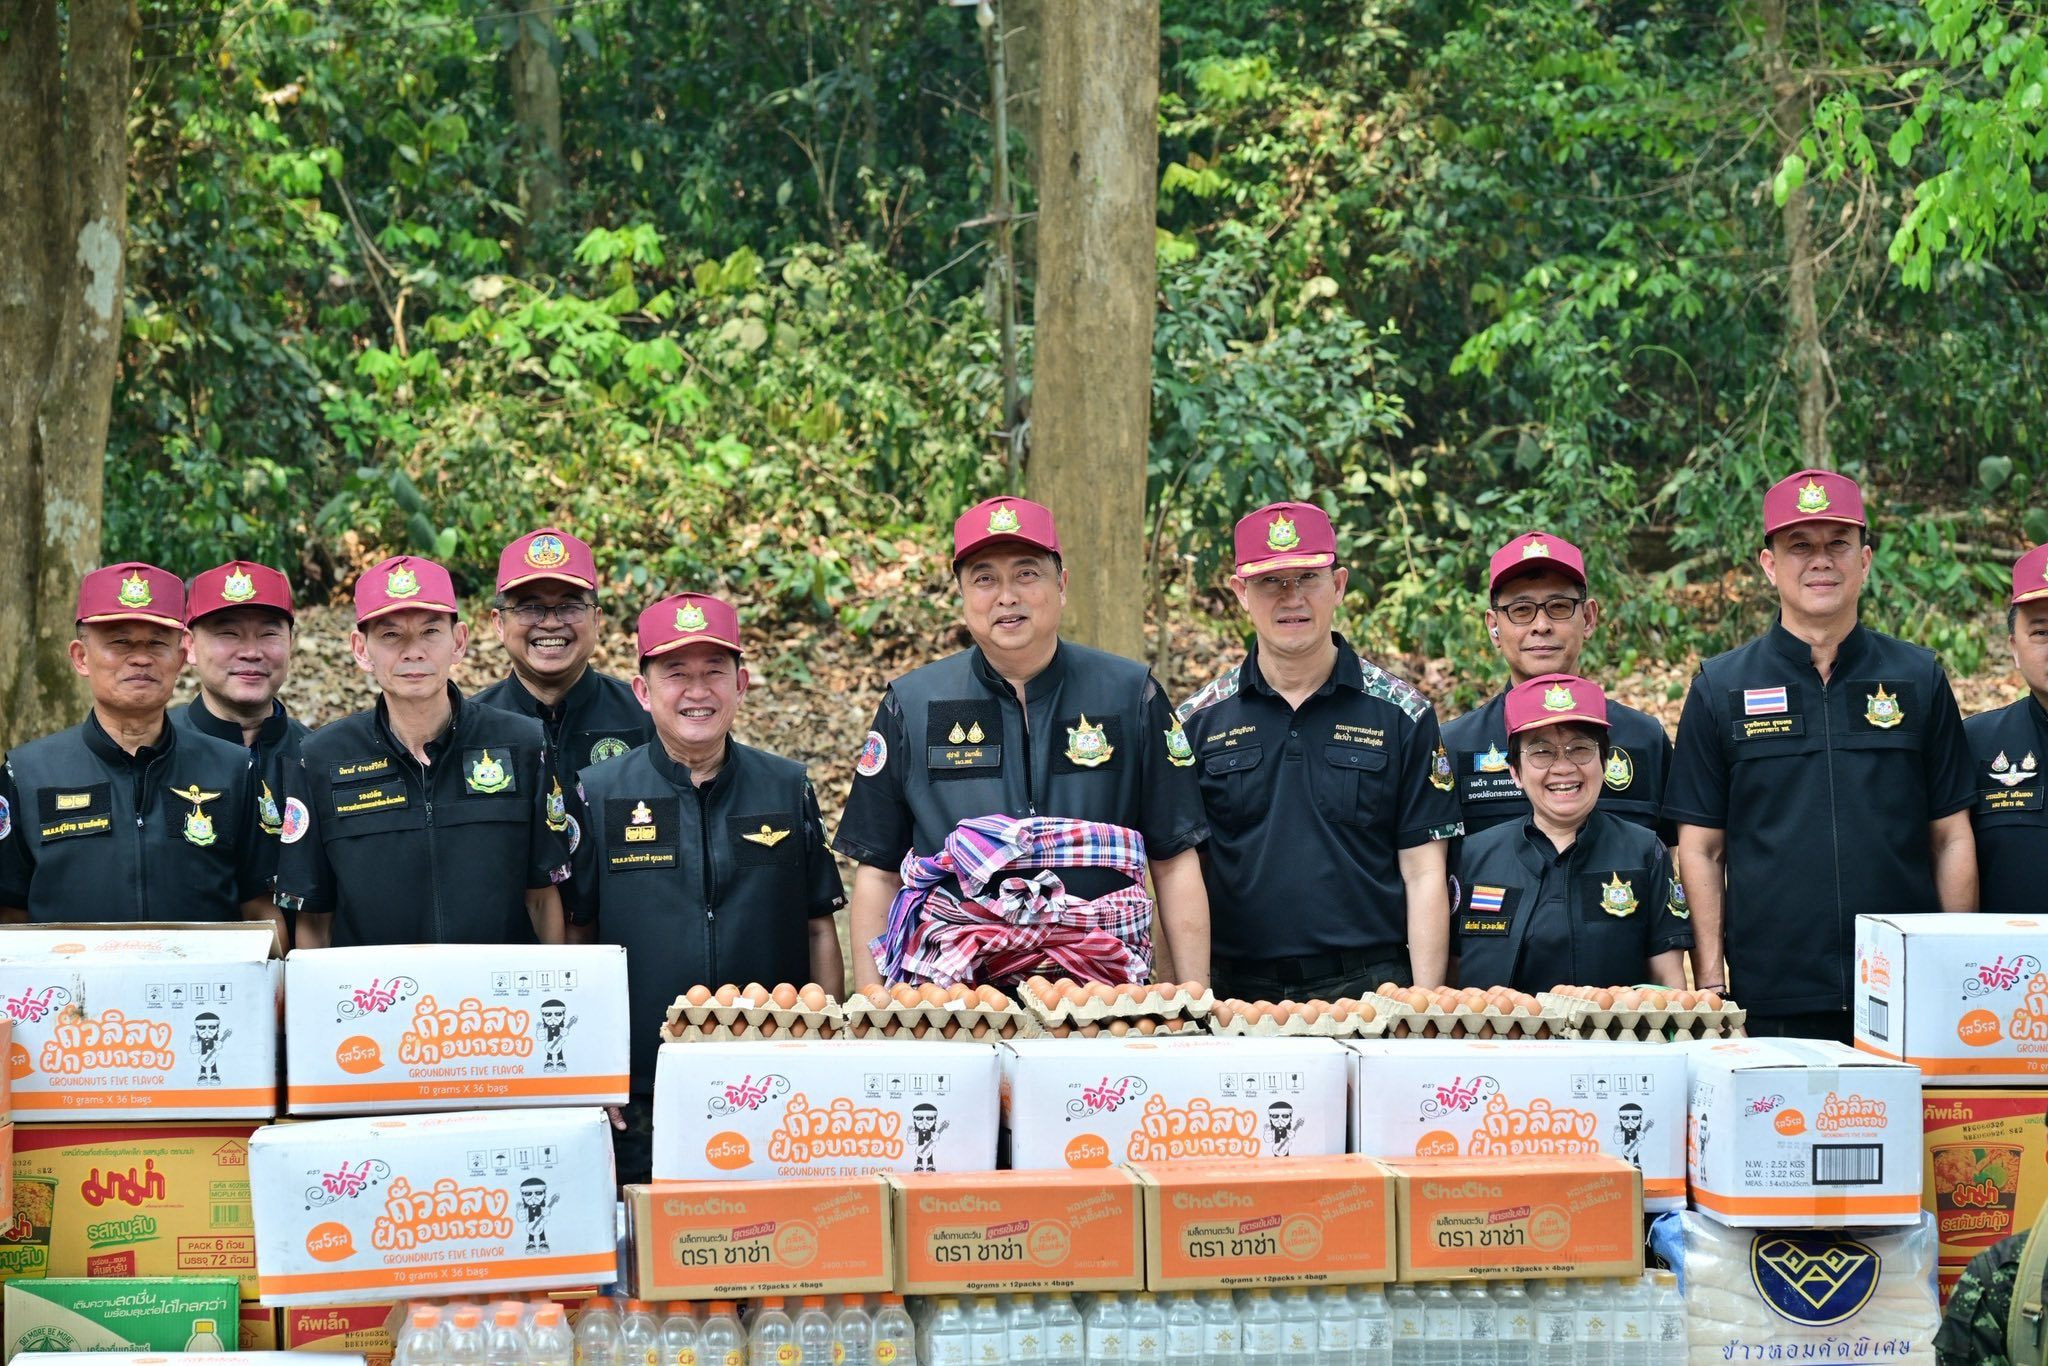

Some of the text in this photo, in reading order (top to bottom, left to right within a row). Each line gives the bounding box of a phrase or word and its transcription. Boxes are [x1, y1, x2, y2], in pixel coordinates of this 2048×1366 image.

[56, 1003, 172, 1049] ถั่วลิสง
[413, 994, 530, 1040] ถั่วลิสง
[49, 1075, 165, 1087] GROUNDNUTS FIVE FLAVOR
[409, 1065, 524, 1078] GROUNDNUTS FIVE FLAVOR
[418, 1086, 430, 1095] 70
[432, 1087, 460, 1097] grams
[473, 1084, 484, 1093] 36
[487, 1083, 508, 1094] bags
[62, 1096, 73, 1105] 70
[76, 1096, 104, 1107] grams
[116, 1095, 128, 1104] 36
[130, 1094, 152, 1106] bags
[1824, 1091, 1886, 1118] ถั่วลิสง
[784, 1093, 901, 1138] ถั่วลิสง
[1141, 1092, 1257, 1139] ถั่วลิสง
[1484, 1092, 1598, 1138] ถั่วลิสง
[1924, 1102, 1973, 1120] คัพเล็ก
[777, 1166, 836, 1177] GROUNDNUTS
[840, 1166, 858, 1176] FIVE
[1771, 1161, 1788, 1169] 2.52
[1790, 1161, 1805, 1169] KGS
[1771, 1170, 1787, 1178] 3.22
[1789, 1170, 1805, 1178] KGS
[82, 1158, 165, 1206] มาม่า
[1422, 1181, 1503, 1200] ChaCha
[386, 1175, 509, 1222] ถั่วลิสง
[1172, 1191, 1254, 1210] ChaCha
[1952, 1179, 1999, 1208] มาม่า
[664, 1197, 747, 1217] ChaCha
[919, 1194, 1002, 1214] ChaCha
[87, 1215, 157, 1242] รสหมูสับ
[1436, 1215, 1484, 1226] เมล็ดทานตะวัน
[1941, 1211, 2009, 1233] รสต้มยำกุ้ง
[679, 1232, 728, 1245] เมล็ดทานตะวัน
[933, 1230, 981, 1241] เมล็ดทานตะวัน
[1187, 1226, 1235, 1237] เมล็ดทานตะวัน
[1438, 1230, 1473, 1247] ตรา
[1480, 1223, 1524, 1246] ชาช่า
[188, 1239, 245, 1251] PACK 6 ถ้วย
[681, 1240, 770, 1266] ตรา ชาช่า
[935, 1238, 1023, 1263] ตรา ชาช่า
[1189, 1240, 1224, 1258] ตรา
[1231, 1233, 1276, 1255] ชาช่า
[184, 1254, 249, 1266] บรรจุ 72 ถ้วย
[383, 1247, 504, 1264] GROUNDNUTS FIVE FLAVOR
[394, 1271, 406, 1281] 70
[409, 1271, 438, 1283] grams
[451, 1268, 463, 1278] 36
[466, 1266, 489, 1278] bags
[1469, 1264, 1575, 1274] 40grams 12packs 4bags
[713, 1281, 823, 1293] 40grams 12packs 4bags
[966, 1279, 1074, 1290] 40grams 12packs 4bags
[1220, 1274, 1327, 1285] 40grams 12packs 4bags
[73, 1291, 156, 1310] เติมความสดชื่น
[297, 1312, 350, 1331] คัพเล็ก
[29, 1327, 47, 1343] MORE
[48, 1327, 55, 1336] BE
[58, 1330, 74, 1347] MORE
[1722, 1336, 1911, 1361] ข้าวหอมคัดพิเศษ
